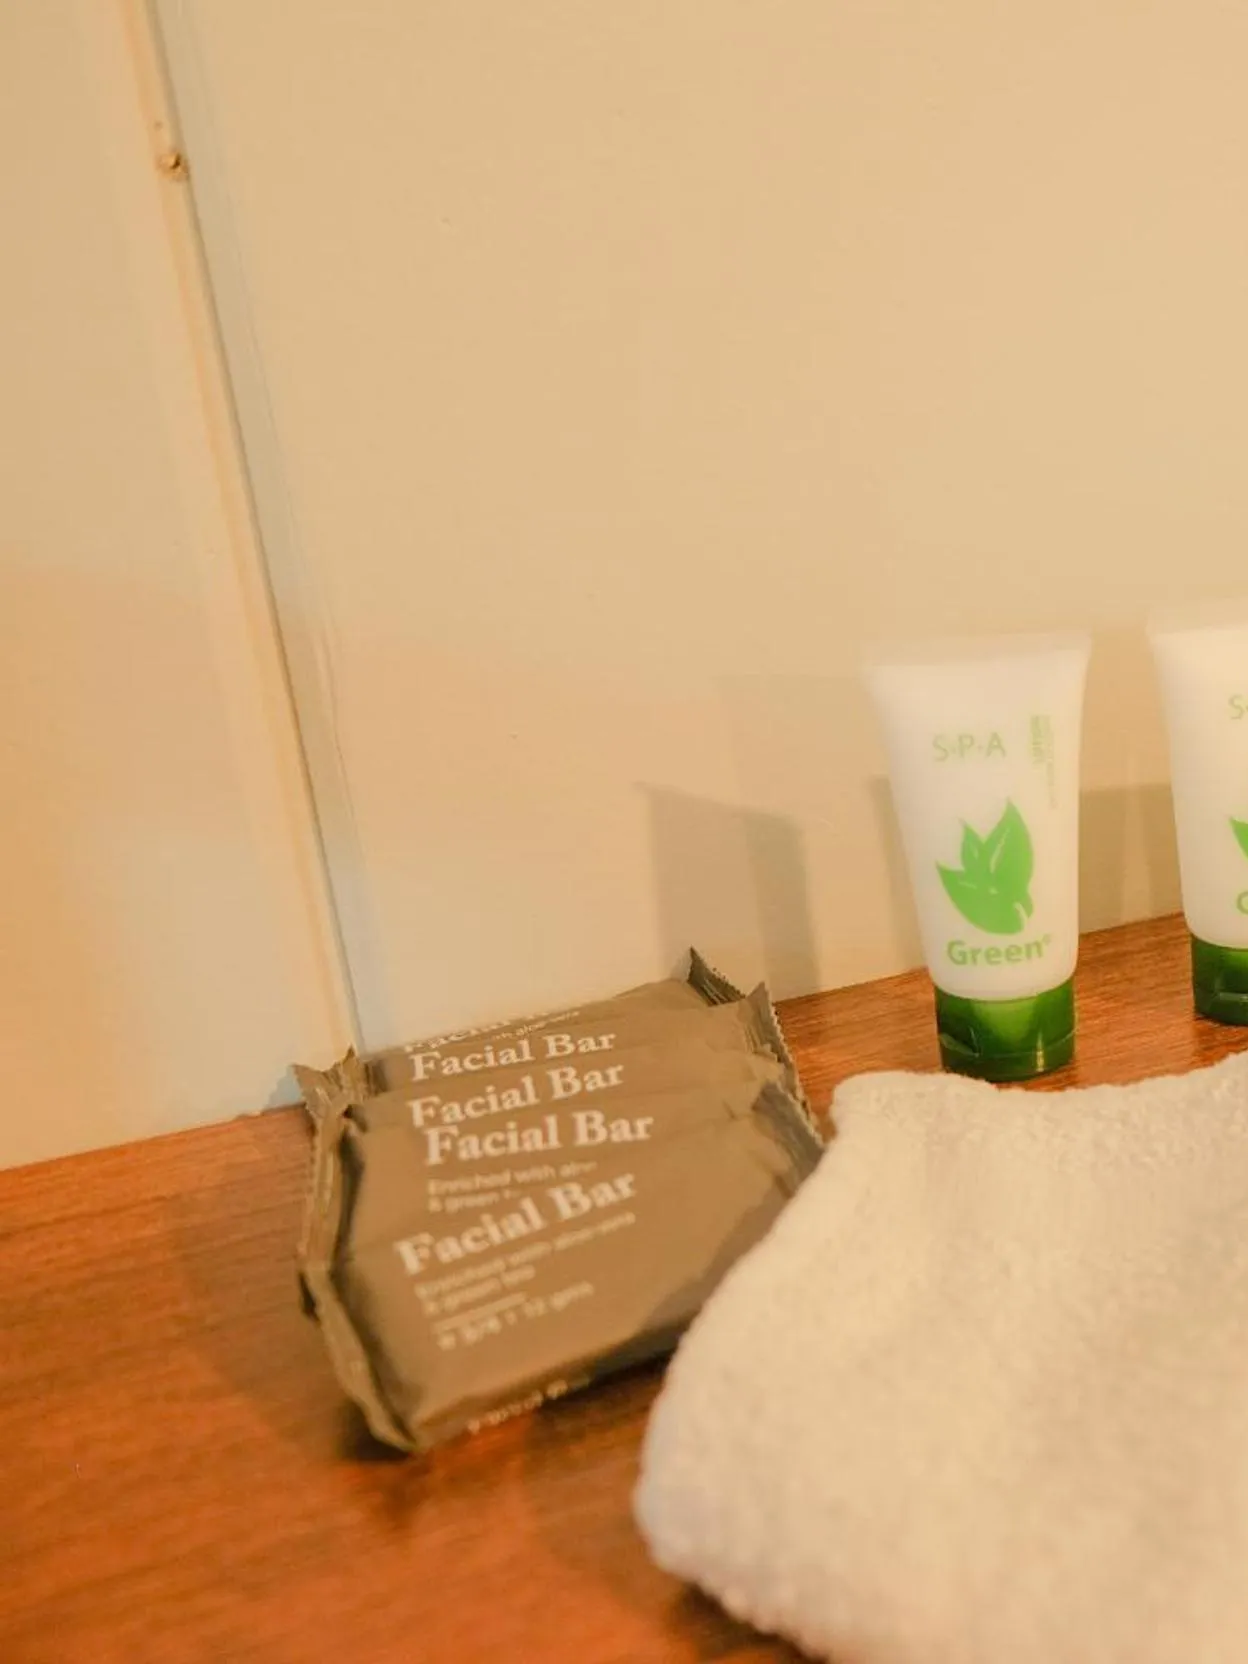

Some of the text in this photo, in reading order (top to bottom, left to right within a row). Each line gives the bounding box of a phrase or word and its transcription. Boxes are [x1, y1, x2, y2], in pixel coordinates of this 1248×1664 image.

[408, 1038, 536, 1082] Facial
[543, 1033, 617, 1059] Bar
[406, 1064, 625, 1128] Facial Bar
[423, 1109, 655, 1166] Facial Bar
[394, 1196, 548, 1276] Facial
[546, 1173, 637, 1222] Bar
